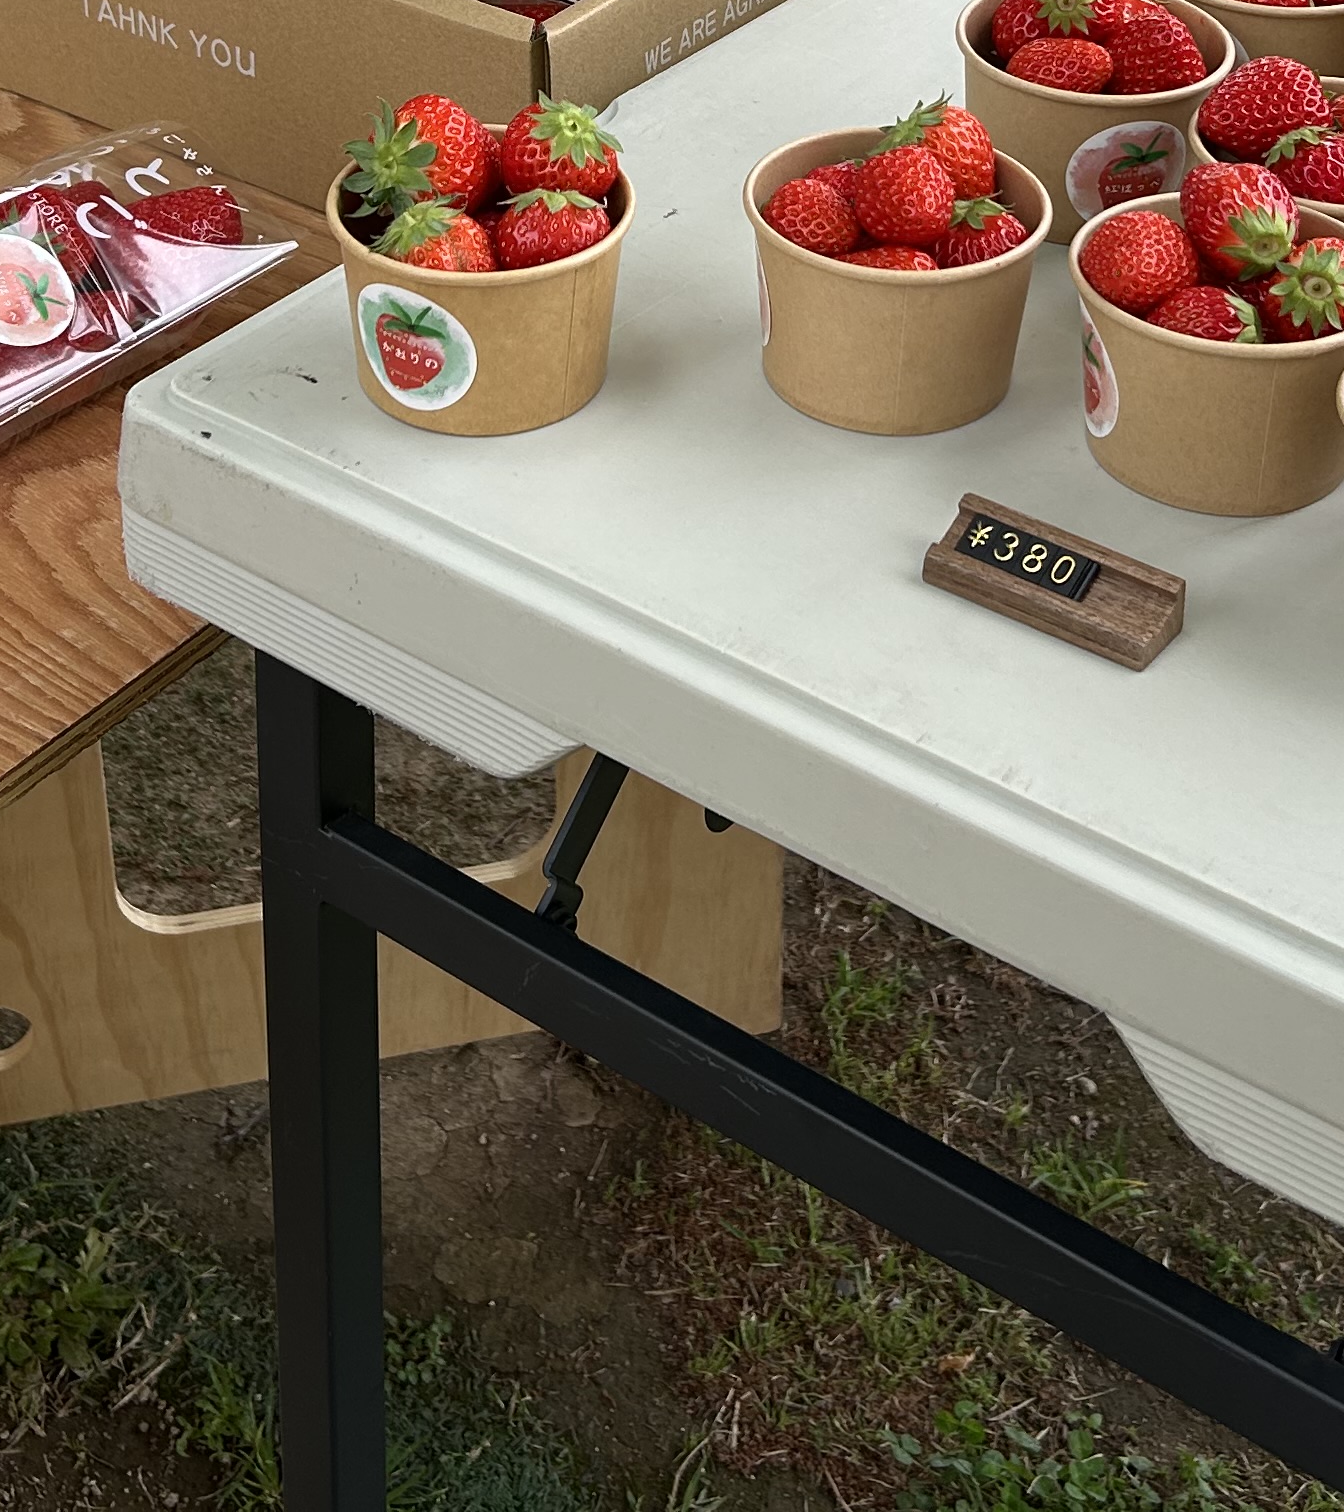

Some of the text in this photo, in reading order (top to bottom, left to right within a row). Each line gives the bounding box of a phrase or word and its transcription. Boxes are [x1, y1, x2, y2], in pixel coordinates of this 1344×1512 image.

[189, 32, 257, 78] YOU
[643, 44, 673, 73] WE
[676, 13, 719, 58] ARE
[27, 191, 68, 236] STORE
[967, 520, 1077, 585] ¥380
